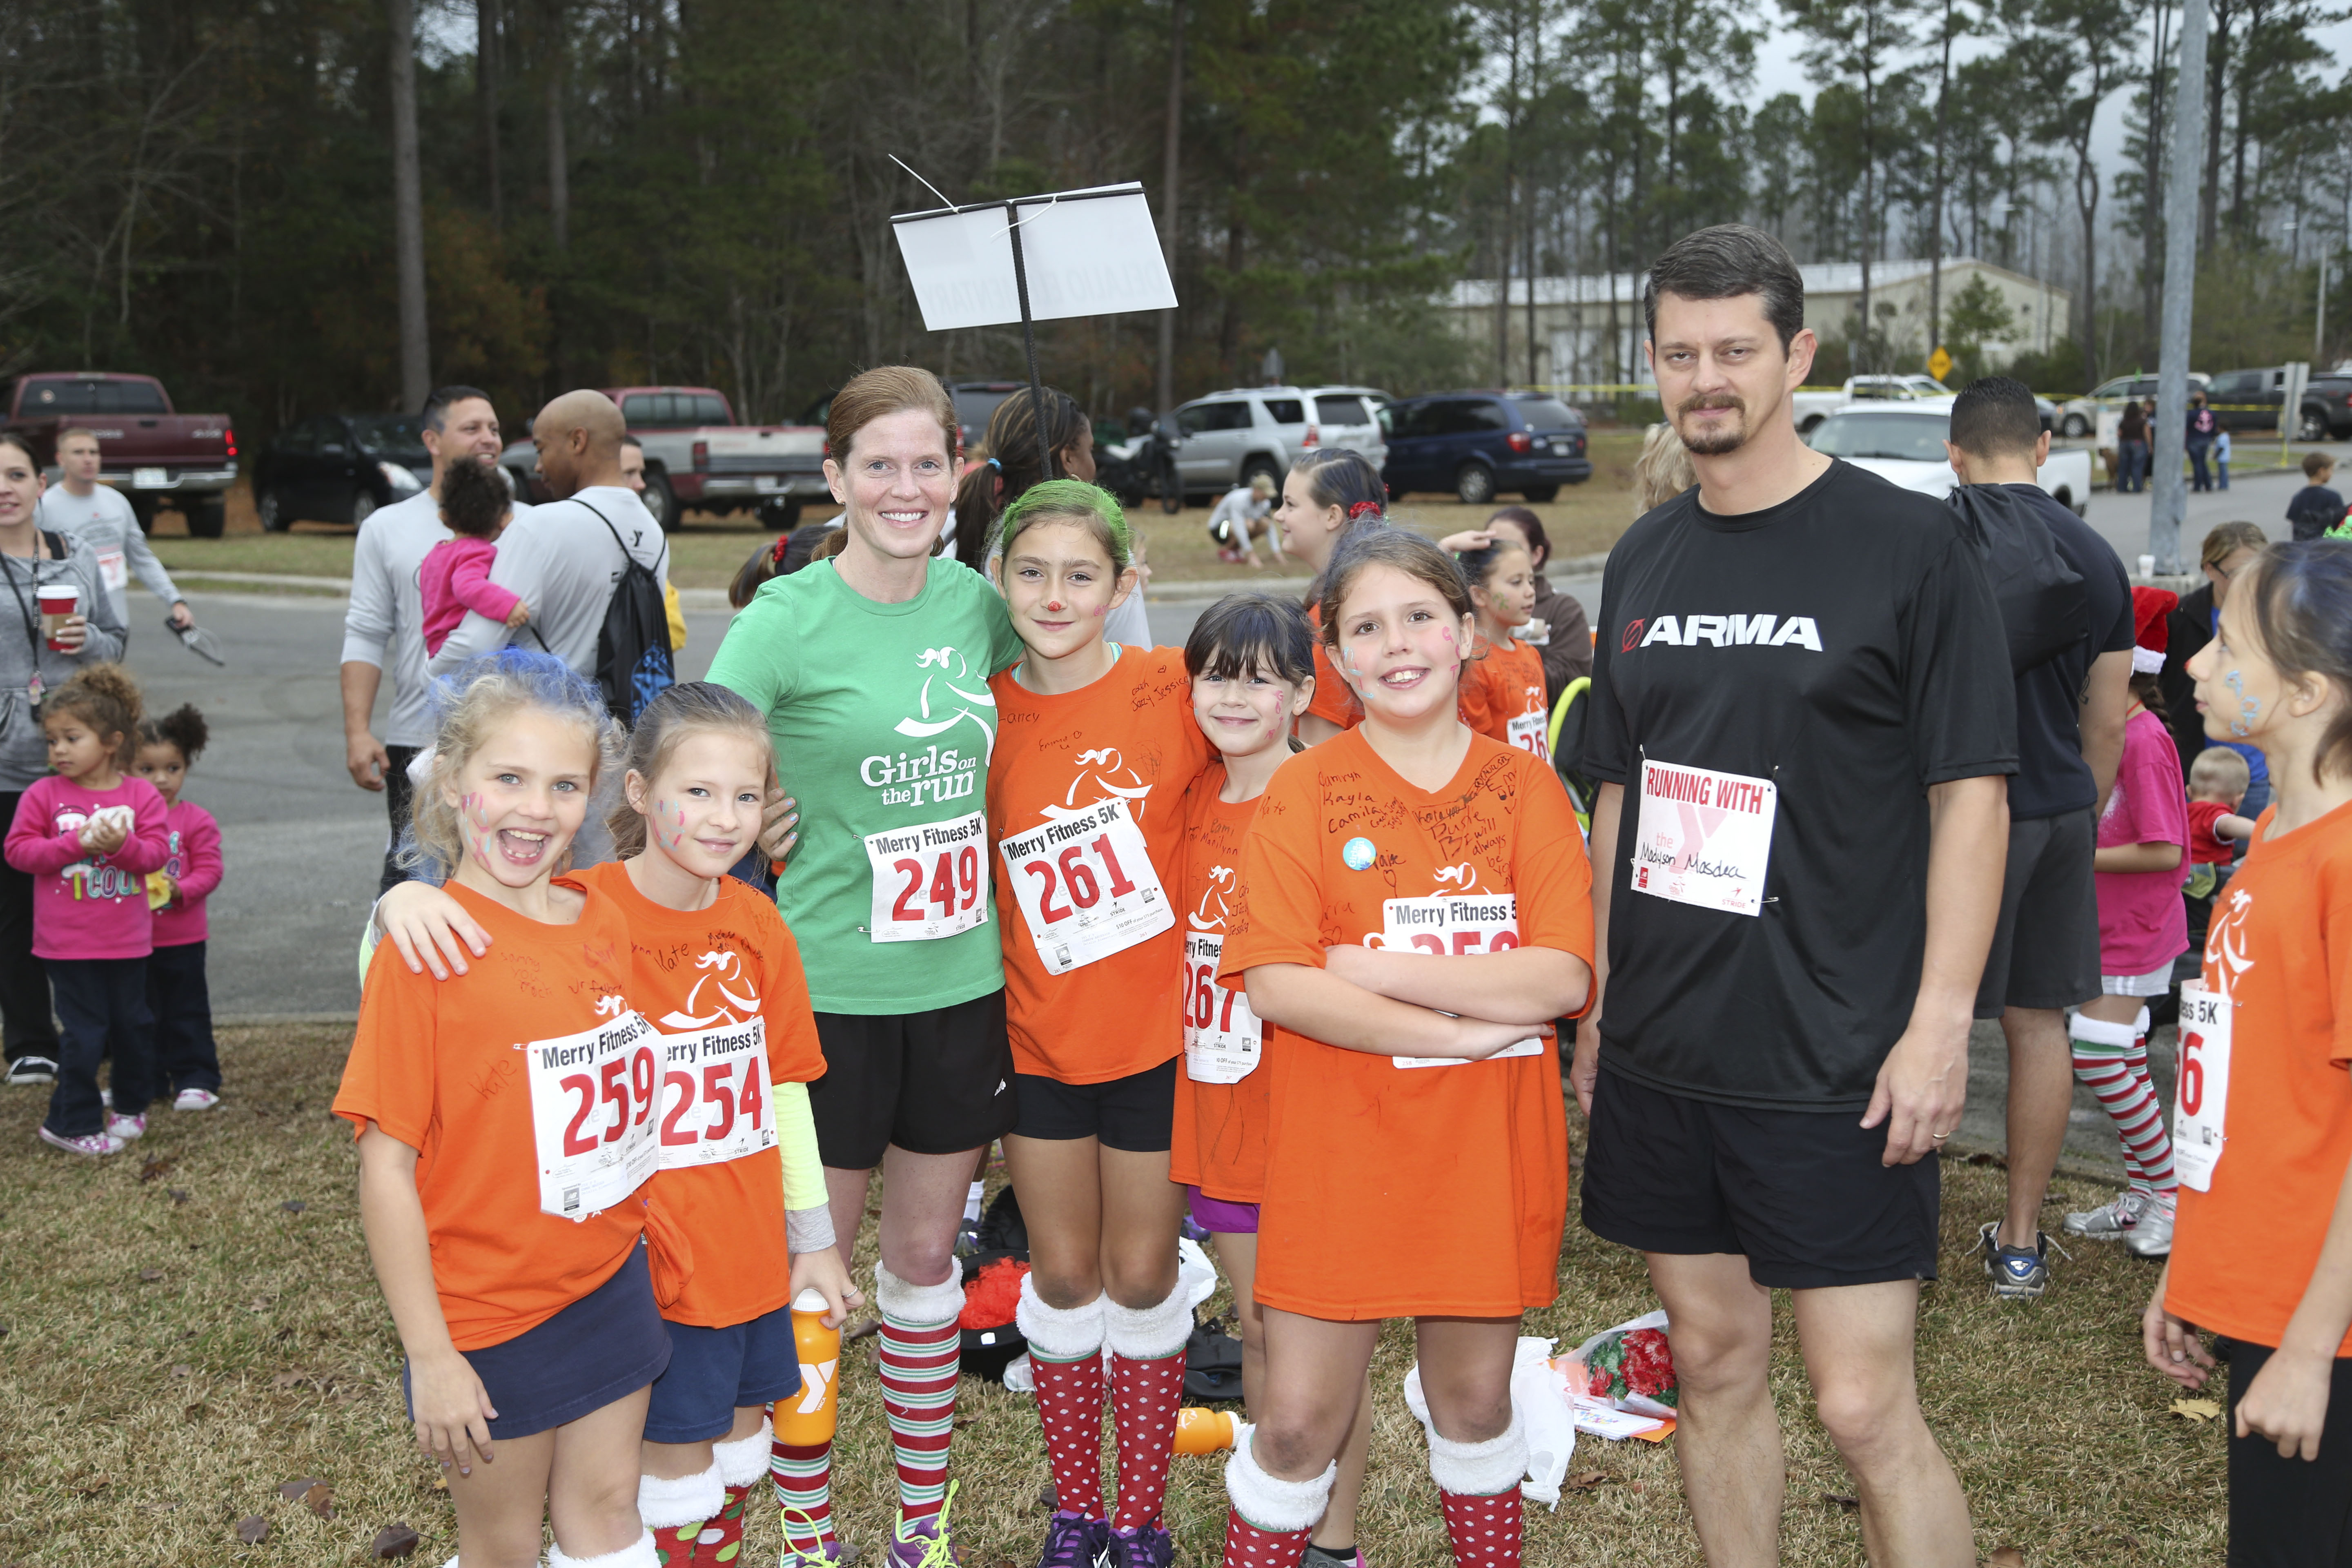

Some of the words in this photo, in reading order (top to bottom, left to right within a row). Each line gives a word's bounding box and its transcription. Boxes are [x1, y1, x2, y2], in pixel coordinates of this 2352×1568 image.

[1639, 614, 1823, 652] ARMA
[860, 745, 958, 787] Girls
[958, 757, 976, 770] on
[881, 788, 911, 805] the
[910, 770, 975, 807] run
[1323, 791, 1378, 805] Kayla
[1647, 767, 1712, 805] RUNNING
[1716, 780, 1764, 814] WITH
[875, 835, 919, 855] Merry
[923, 826, 968, 846] Fitness
[969, 817, 982, 836] 5K
[1007, 835, 1045, 860] Merry
[1046, 815, 1097, 844] Fitness
[1098, 804, 1120, 824] 5K
[1329, 806, 1381, 833] Camila
[1656, 832, 1673, 849] the
[892, 846, 978, 921] 249
[1024, 833, 1136, 924] 261
[1110, 907, 1126, 917] STRIDE
[1396, 905, 1444, 927] Merry
[1450, 902, 1507, 922] Fitness
[1722, 898, 1746, 909] STRIDE
[654, 943, 690, 974] Kate
[2198, 1000, 2218, 1025] 5K
[542, 1042, 595, 1069] Merry
[599, 1023, 638, 1055] Fitness
[634, 1014, 652, 1035] 5K
[702, 1033, 751, 1056] Fitness
[753, 1023, 762, 1046] 5K
[559, 1047, 655, 1157] 259
[661, 1056, 762, 1146] 254
[734, 1147, 749, 1155] STRIDE
[816, 1397, 826, 1411] YMCA
